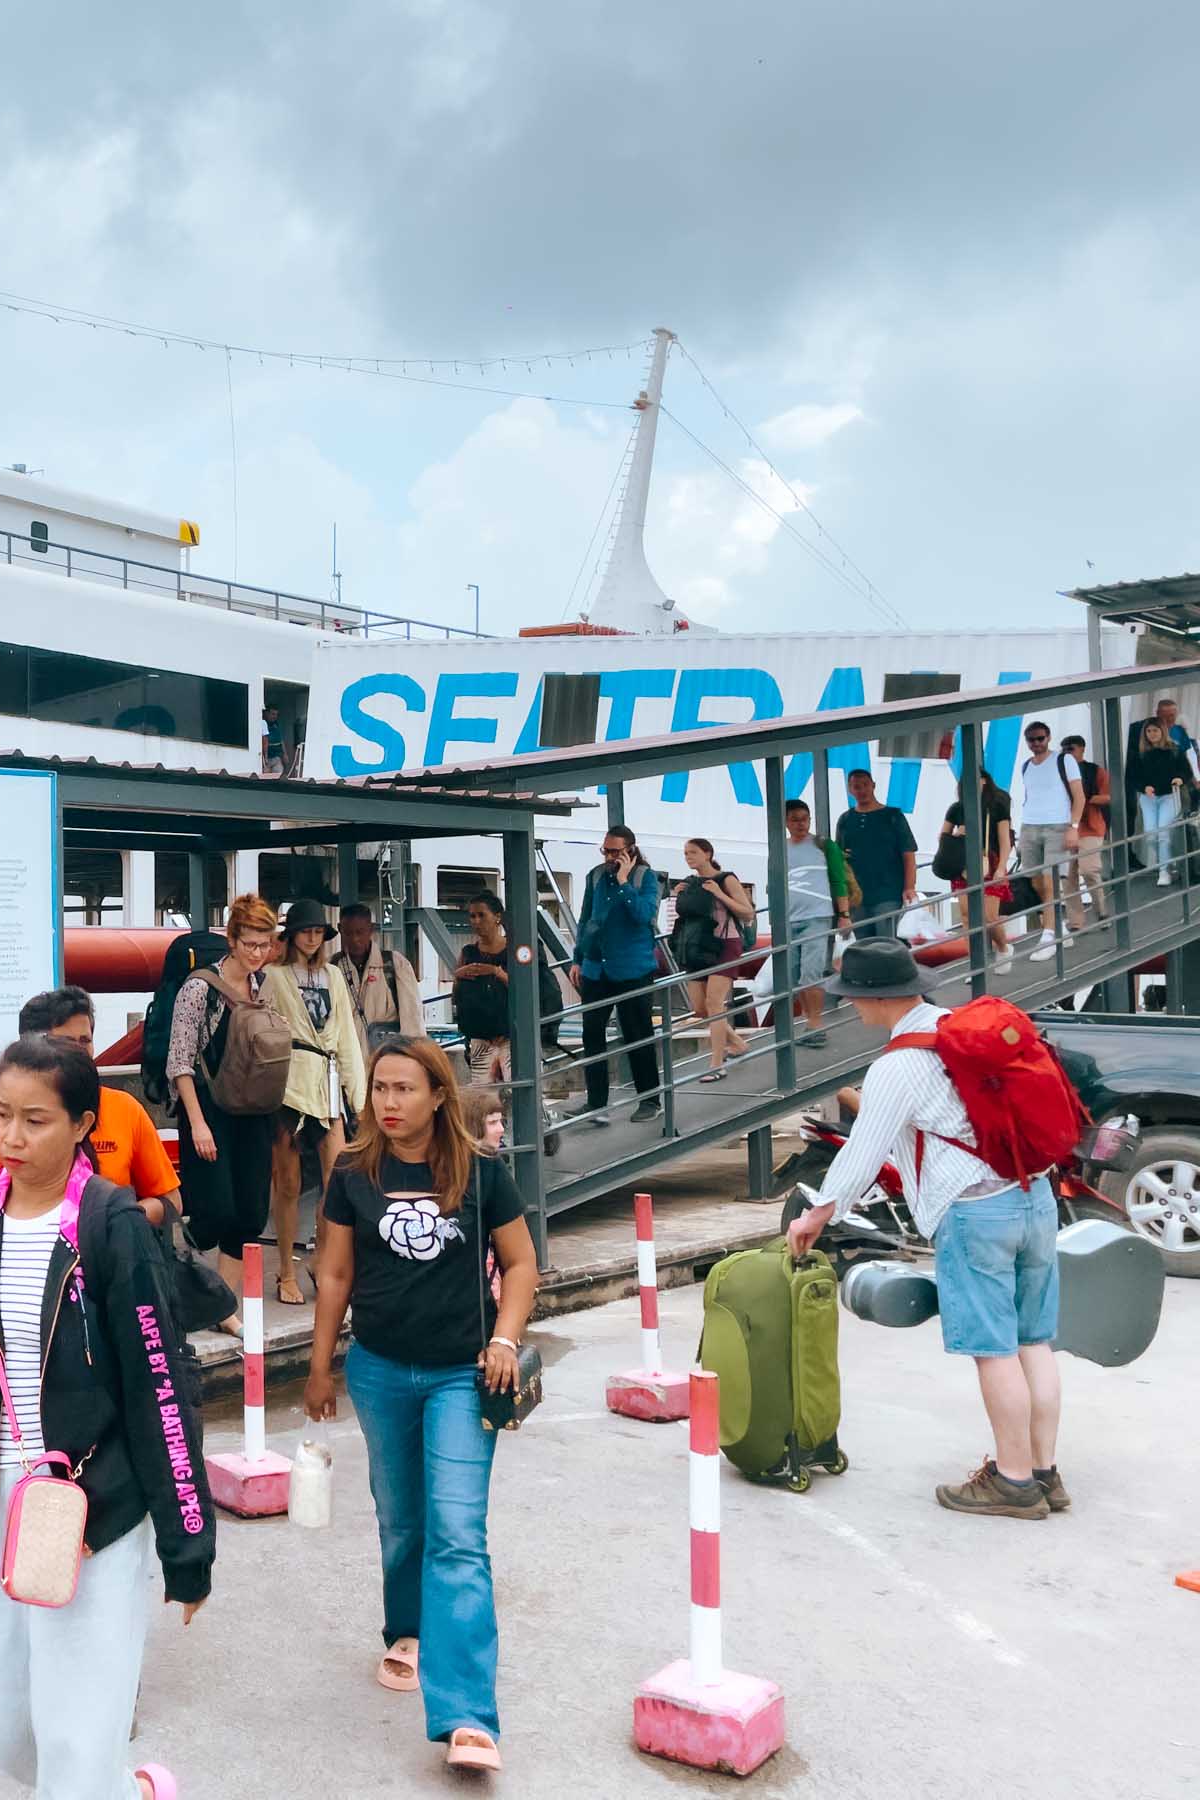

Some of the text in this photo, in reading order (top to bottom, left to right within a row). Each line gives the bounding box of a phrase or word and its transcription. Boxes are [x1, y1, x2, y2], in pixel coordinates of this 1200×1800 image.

[136, 1304, 163, 1351] AAPE
[149, 1351, 170, 1375] BY
[159, 1403, 193, 1481] BATHING
